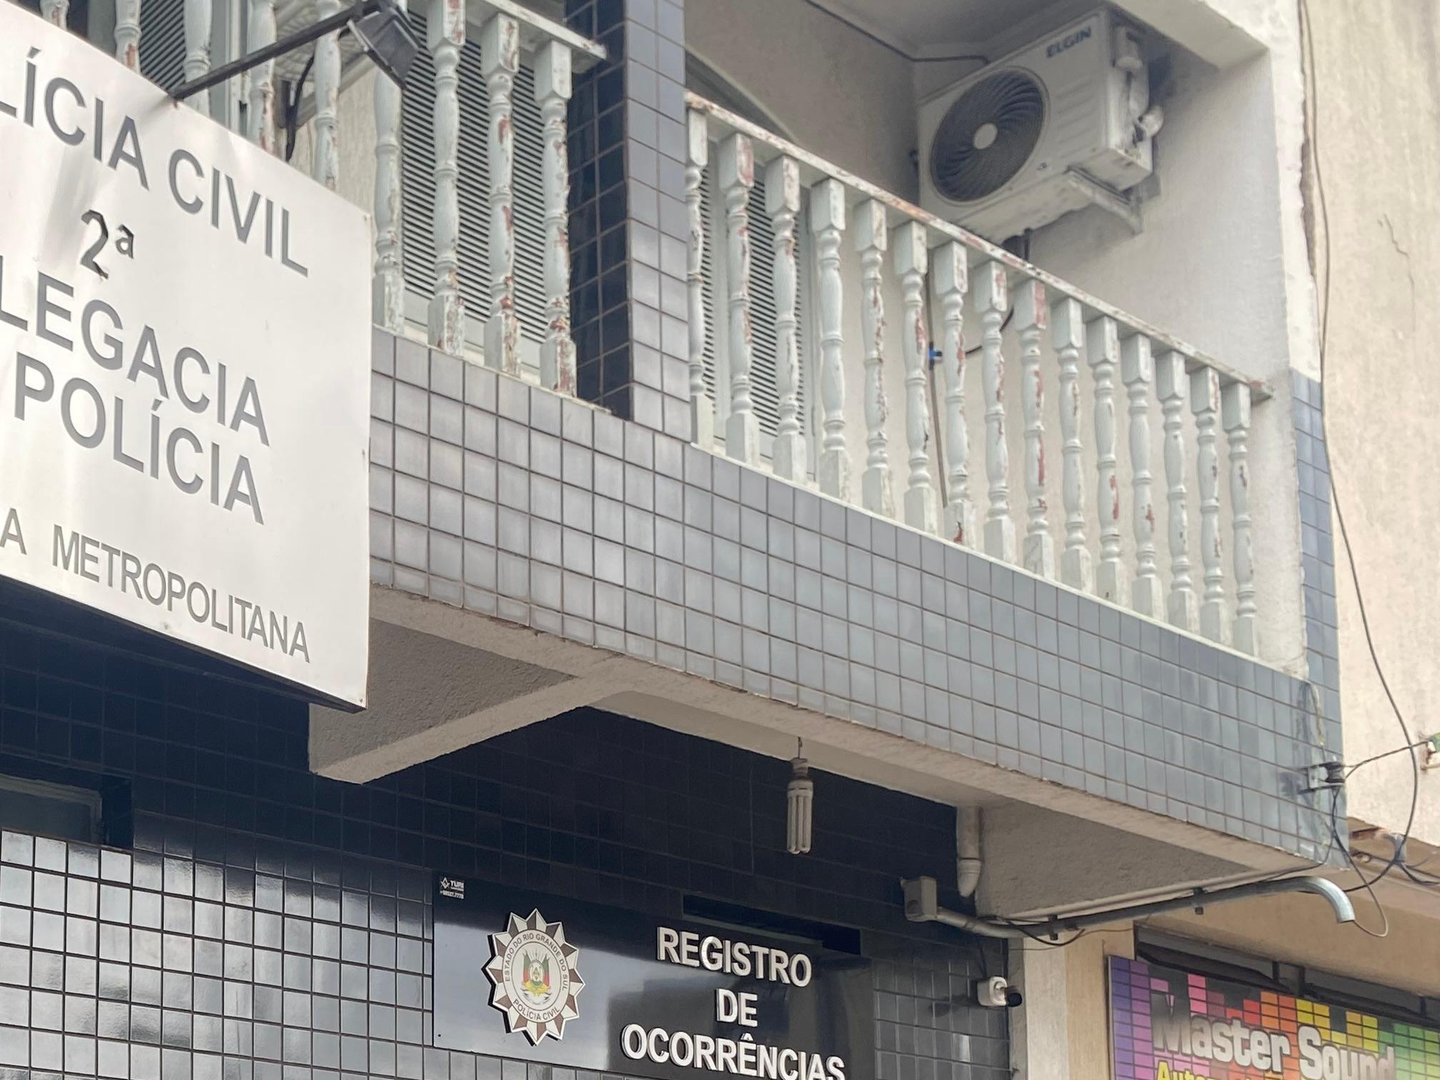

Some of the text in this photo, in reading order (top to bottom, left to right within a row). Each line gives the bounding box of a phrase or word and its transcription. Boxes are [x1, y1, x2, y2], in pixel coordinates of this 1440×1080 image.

[1046, 25, 1092, 58] ELGIN
[168, 147, 309, 279] CIVIL
[14, 349, 265, 526] POLÍCIA
[52, 523, 311, 664] METROPOLITANA
[505, 948, 515, 982] ESTADO
[522, 932, 535, 941] RIO
[535, 934, 561, 957] GRANDE
[656, 926, 813, 988] REGISTRO
[542, 1006, 560, 1021] CIVIL
[715, 988, 759, 1028] DE
[1150, 993, 1292, 1075] Master
